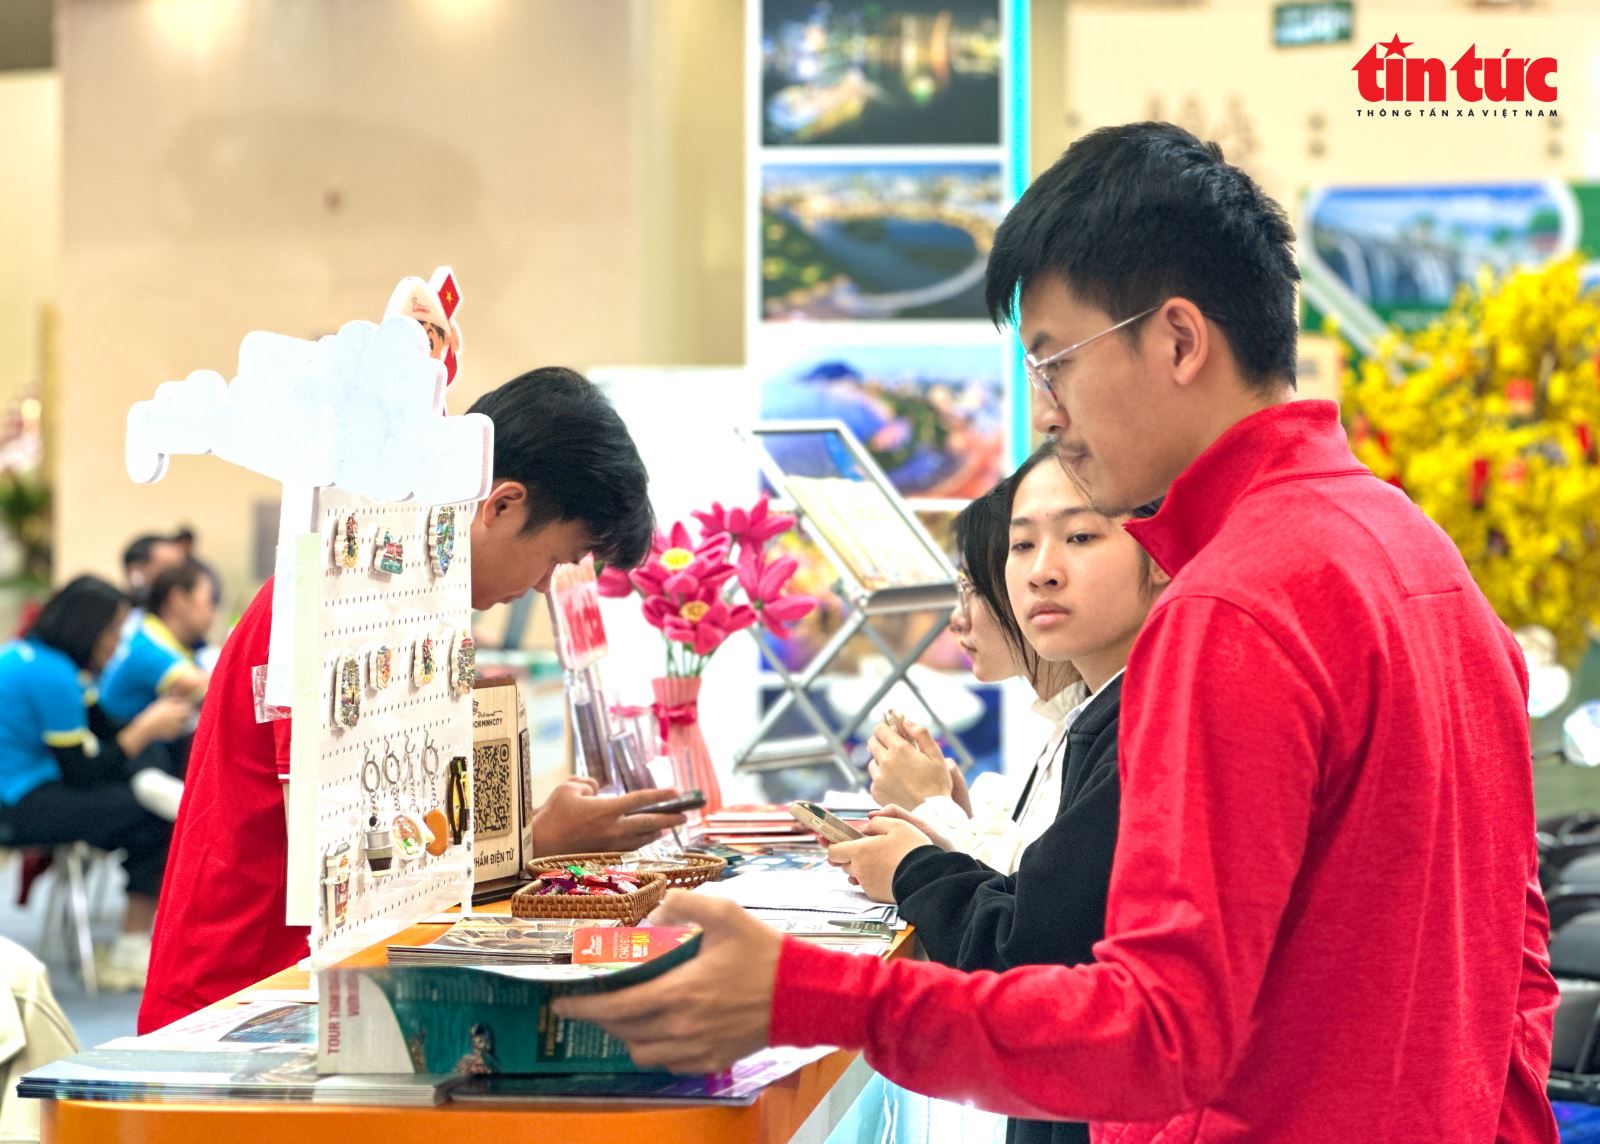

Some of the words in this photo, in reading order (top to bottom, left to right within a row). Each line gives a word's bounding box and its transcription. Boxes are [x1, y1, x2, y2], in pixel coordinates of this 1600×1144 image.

[493, 718, 502, 726] CITY
[490, 849, 505, 867] ĐIỆN
[327, 1021, 341, 1056] TOUR
